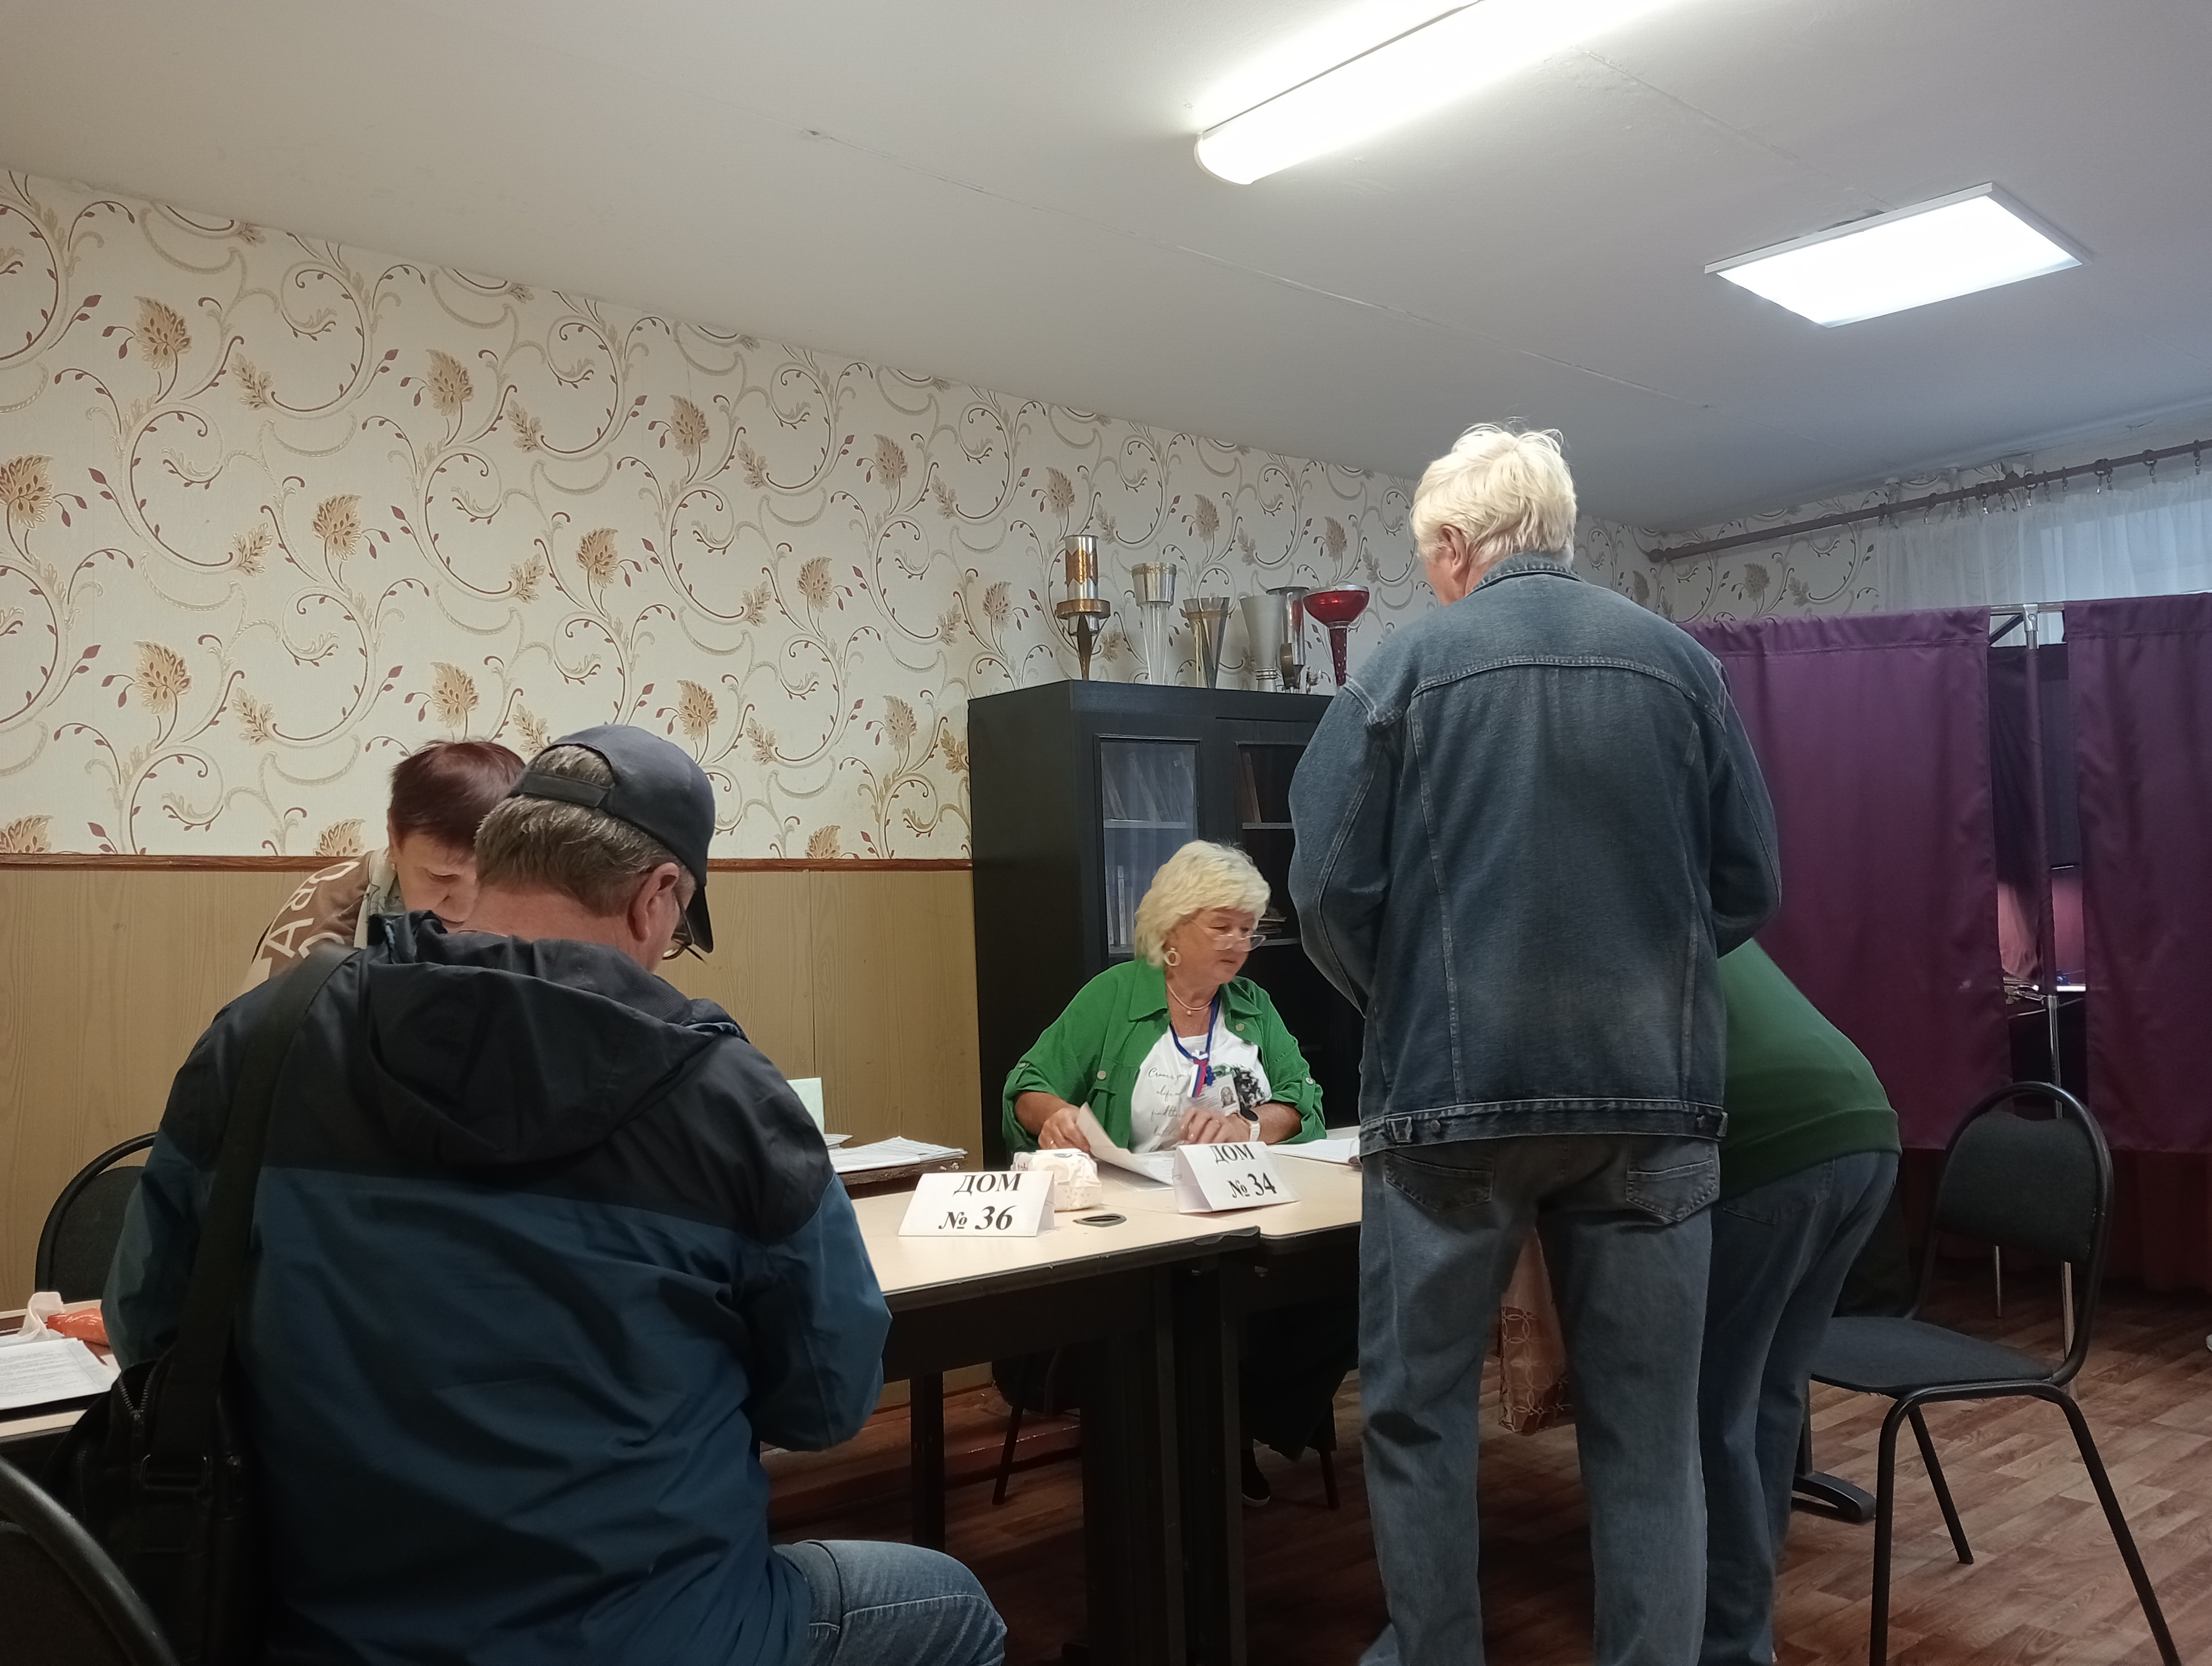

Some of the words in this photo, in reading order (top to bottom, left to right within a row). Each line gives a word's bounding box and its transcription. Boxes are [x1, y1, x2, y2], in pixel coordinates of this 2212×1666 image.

[1209, 1144, 1256, 1166] ДОМ
[952, 1172, 1024, 1197] ДОМ
[1226, 1179, 1250, 1199] №
[1247, 1171, 1277, 1196] 34
[938, 1211, 968, 1229] №
[974, 1204, 1018, 1231] 36
